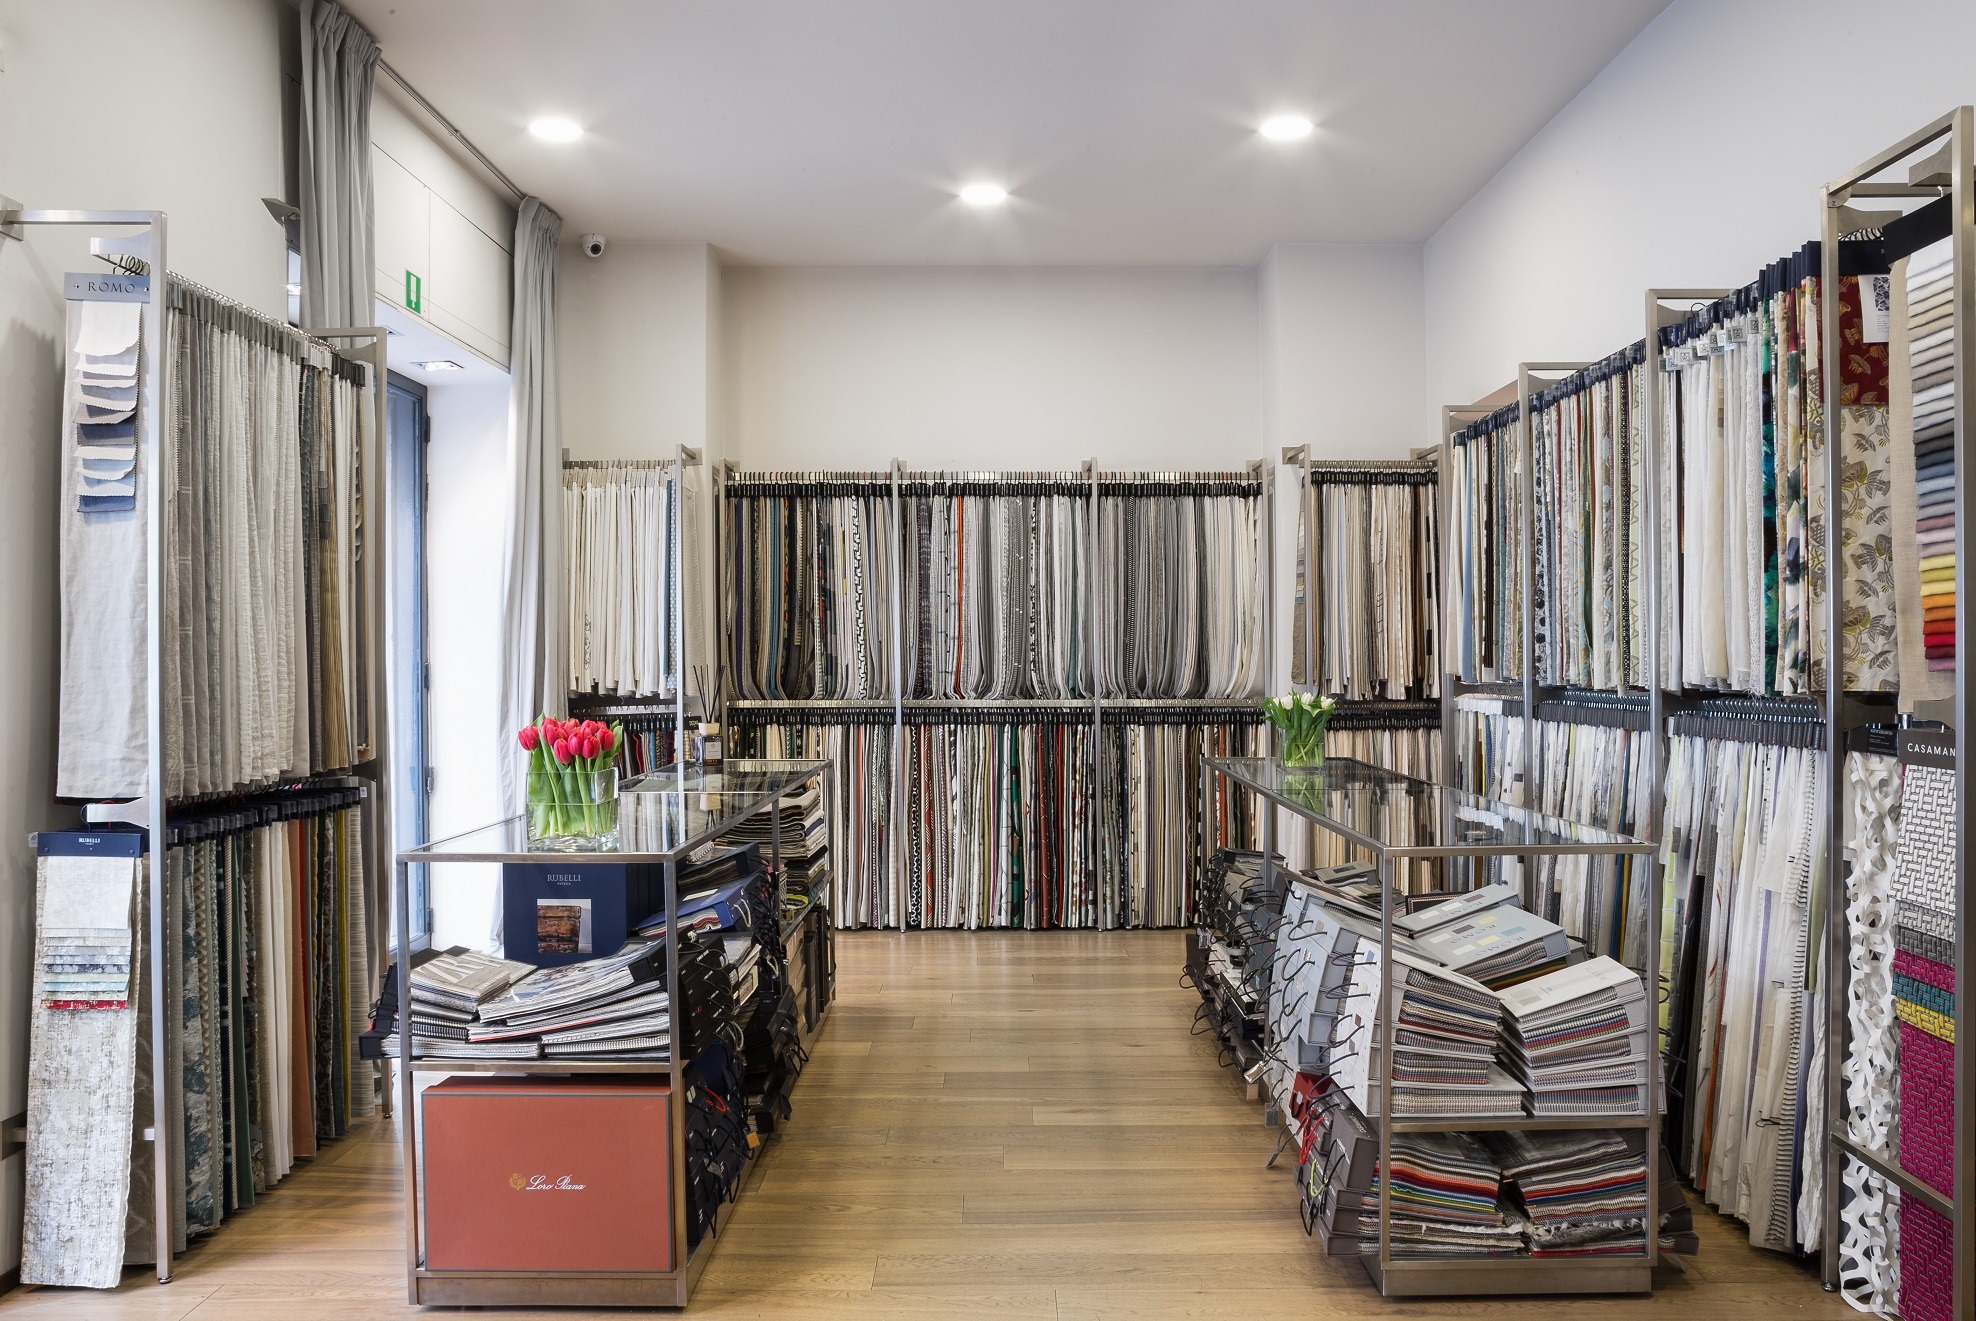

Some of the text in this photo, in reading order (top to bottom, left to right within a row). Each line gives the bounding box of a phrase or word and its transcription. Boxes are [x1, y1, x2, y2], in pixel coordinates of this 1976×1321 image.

[88, 281, 136, 294] ROMO
[547, 874, 581, 882] RUBELLI
[1450, 924, 1496, 944] ROMO
[1475, 936, 1524, 956] ROMO
[526, 1174, 586, 1190] Loro Piana
